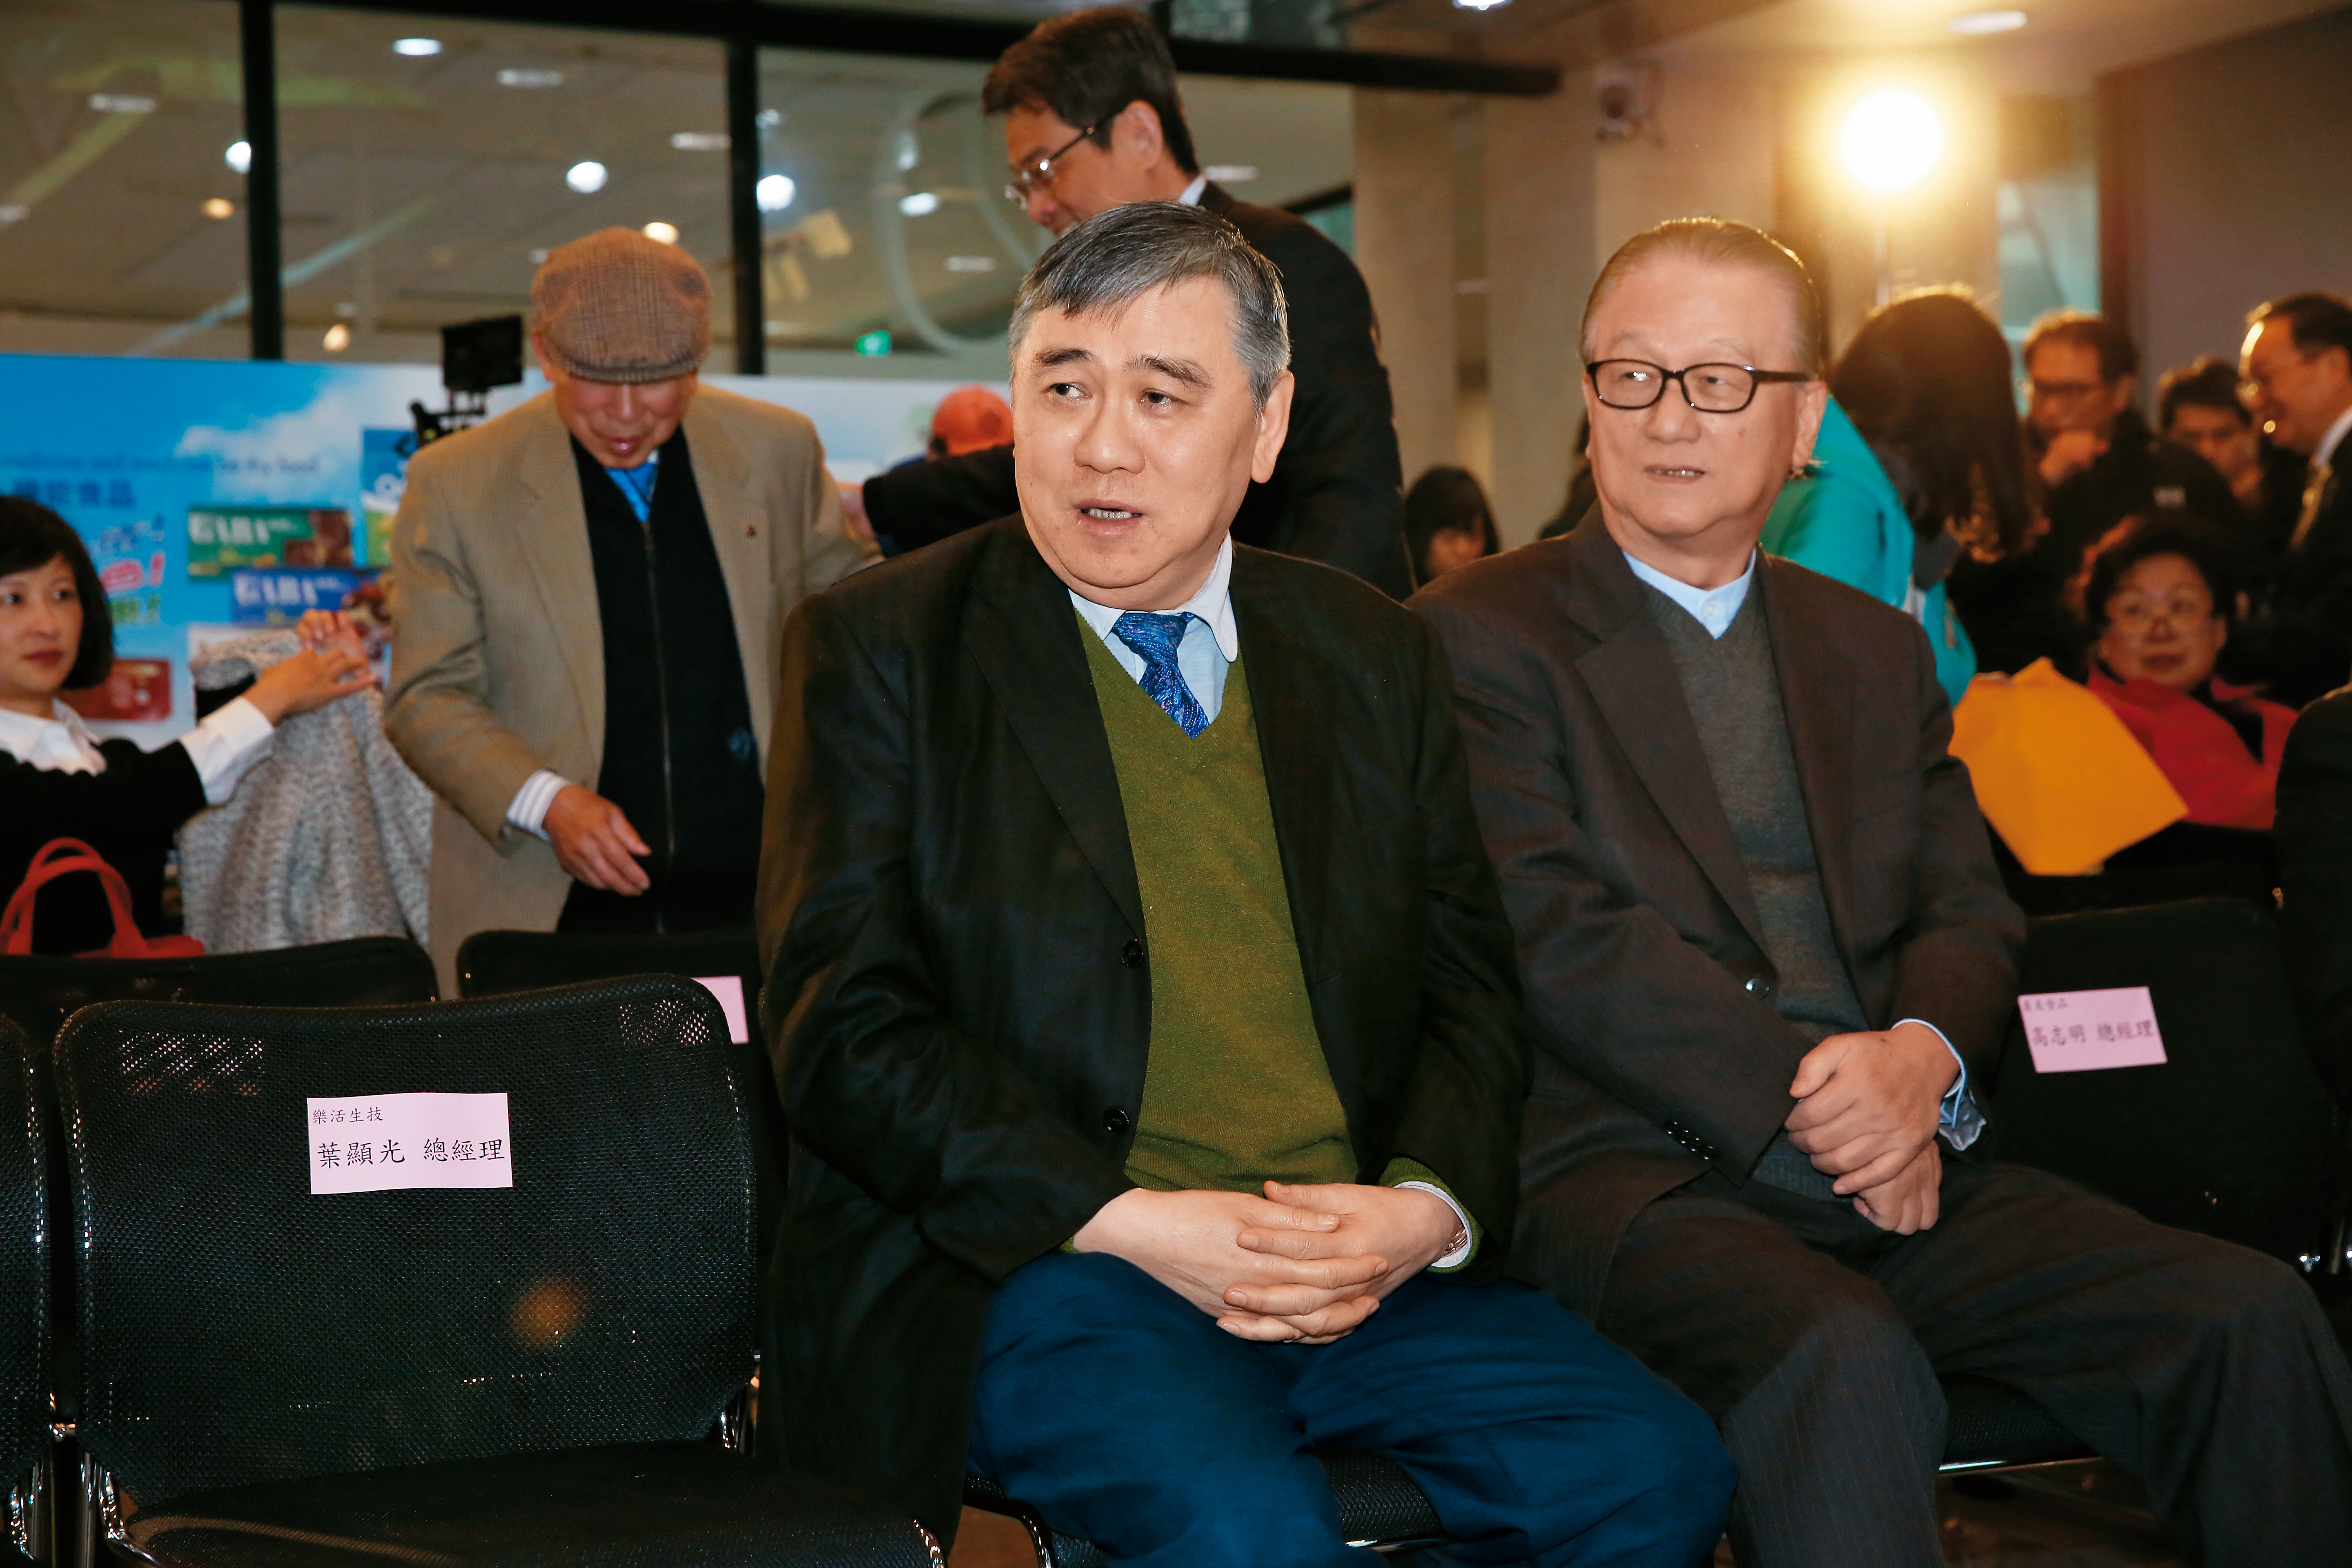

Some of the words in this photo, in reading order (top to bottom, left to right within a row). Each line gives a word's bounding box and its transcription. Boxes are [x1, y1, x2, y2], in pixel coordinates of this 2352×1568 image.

[312, 1107, 384, 1125] 樂活生技
[317, 1139, 405, 1169] 葉顯光
[423, 1137, 505, 1162] 總經理
